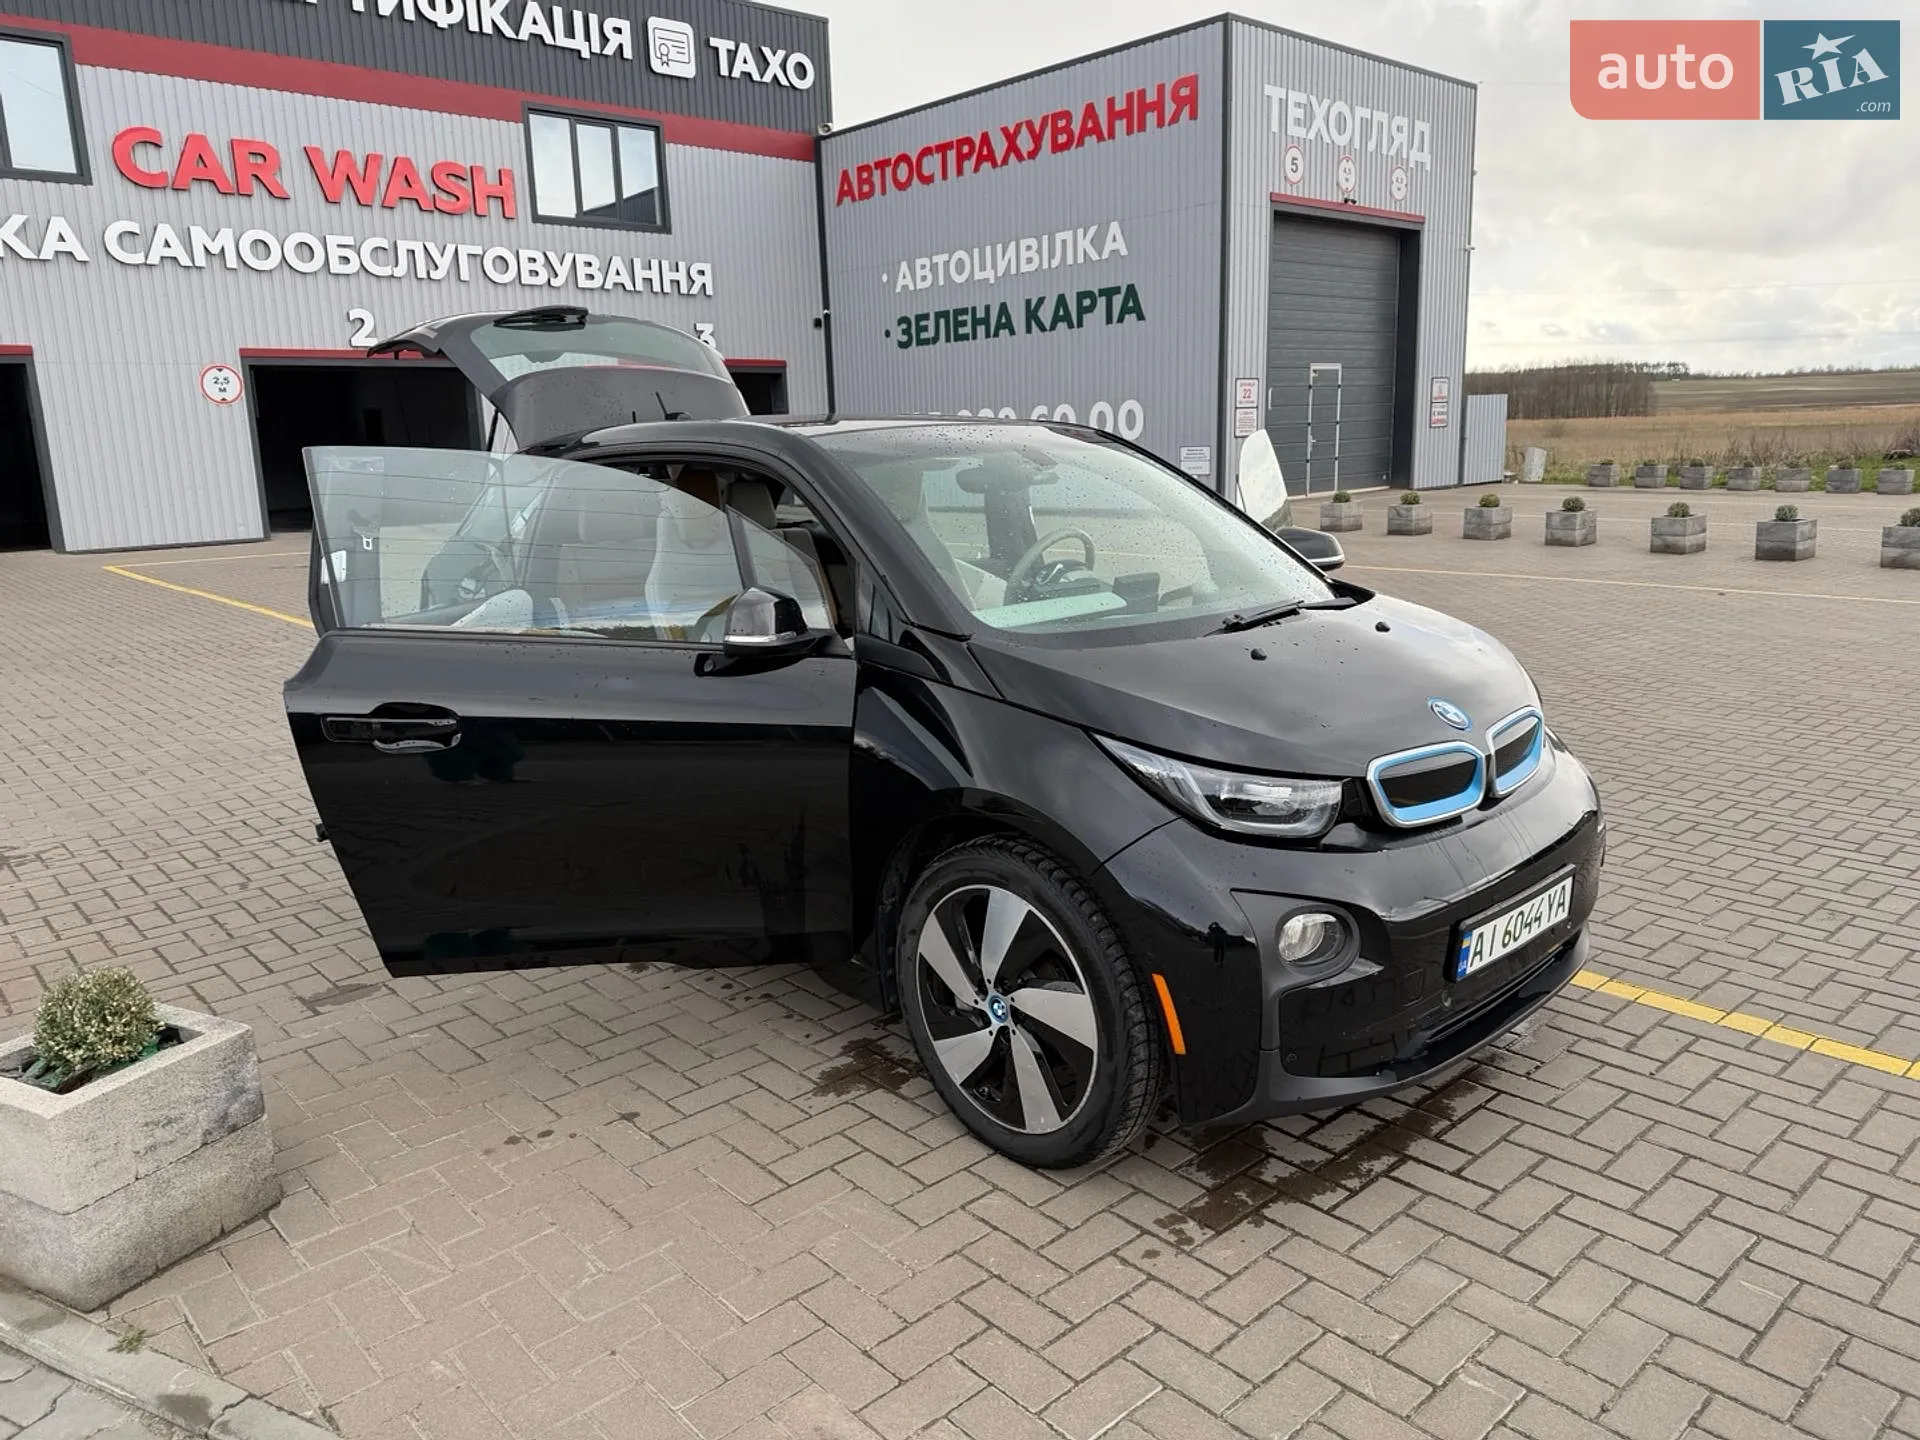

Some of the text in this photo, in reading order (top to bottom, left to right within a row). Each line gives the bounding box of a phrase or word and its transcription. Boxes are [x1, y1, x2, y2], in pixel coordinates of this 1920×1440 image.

[709, 37, 815, 90] ТАХО
[836, 73, 1199, 206] АВТОСТРАХУВАННЯ
[1264, 84, 1431, 171] ТЕХОГЛЯД
[112, 125, 517, 219] CAR WASH
[1290, 157, 1299, 173] 5
[104, 219, 713, 297] САМООБСЛУГОВУВАННЯ
[895, 220, 1129, 293] АВТОЦИВІЛКА
[349, 308, 378, 347] 2
[696, 322, 717, 349] 3
[897, 283, 1146, 349] ЗЕЛЕНА КАРТА
[1502, 897, 1545, 949] 6044
